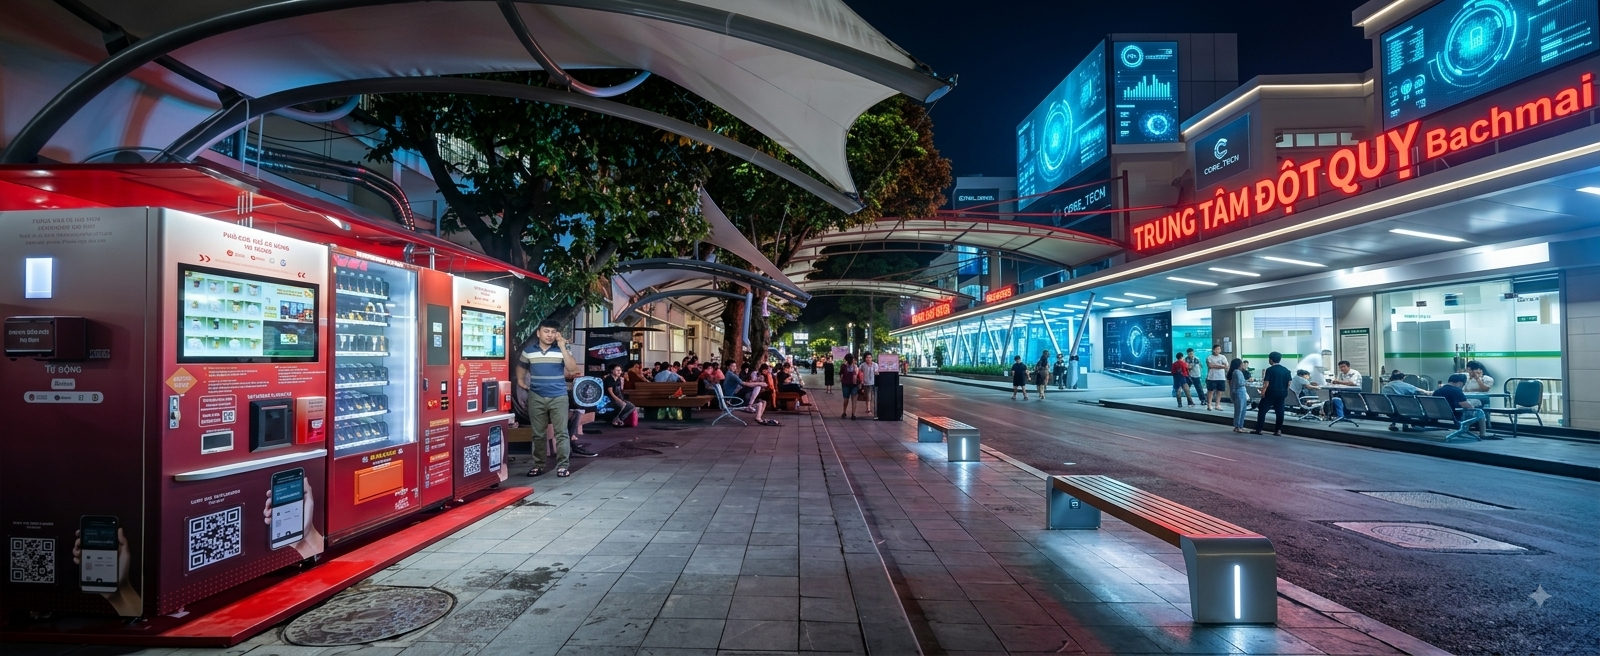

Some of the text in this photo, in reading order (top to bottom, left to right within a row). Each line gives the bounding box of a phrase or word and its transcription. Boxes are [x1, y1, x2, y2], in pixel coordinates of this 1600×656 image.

[1133, 208, 1196, 251] TRUNG
[1199, 186, 1249, 230] TÂM
[1255, 161, 1321, 214] ĐỘT
[1328, 121, 1420, 195] QUỴ
[1426, 72, 1593, 160] Bachmai
